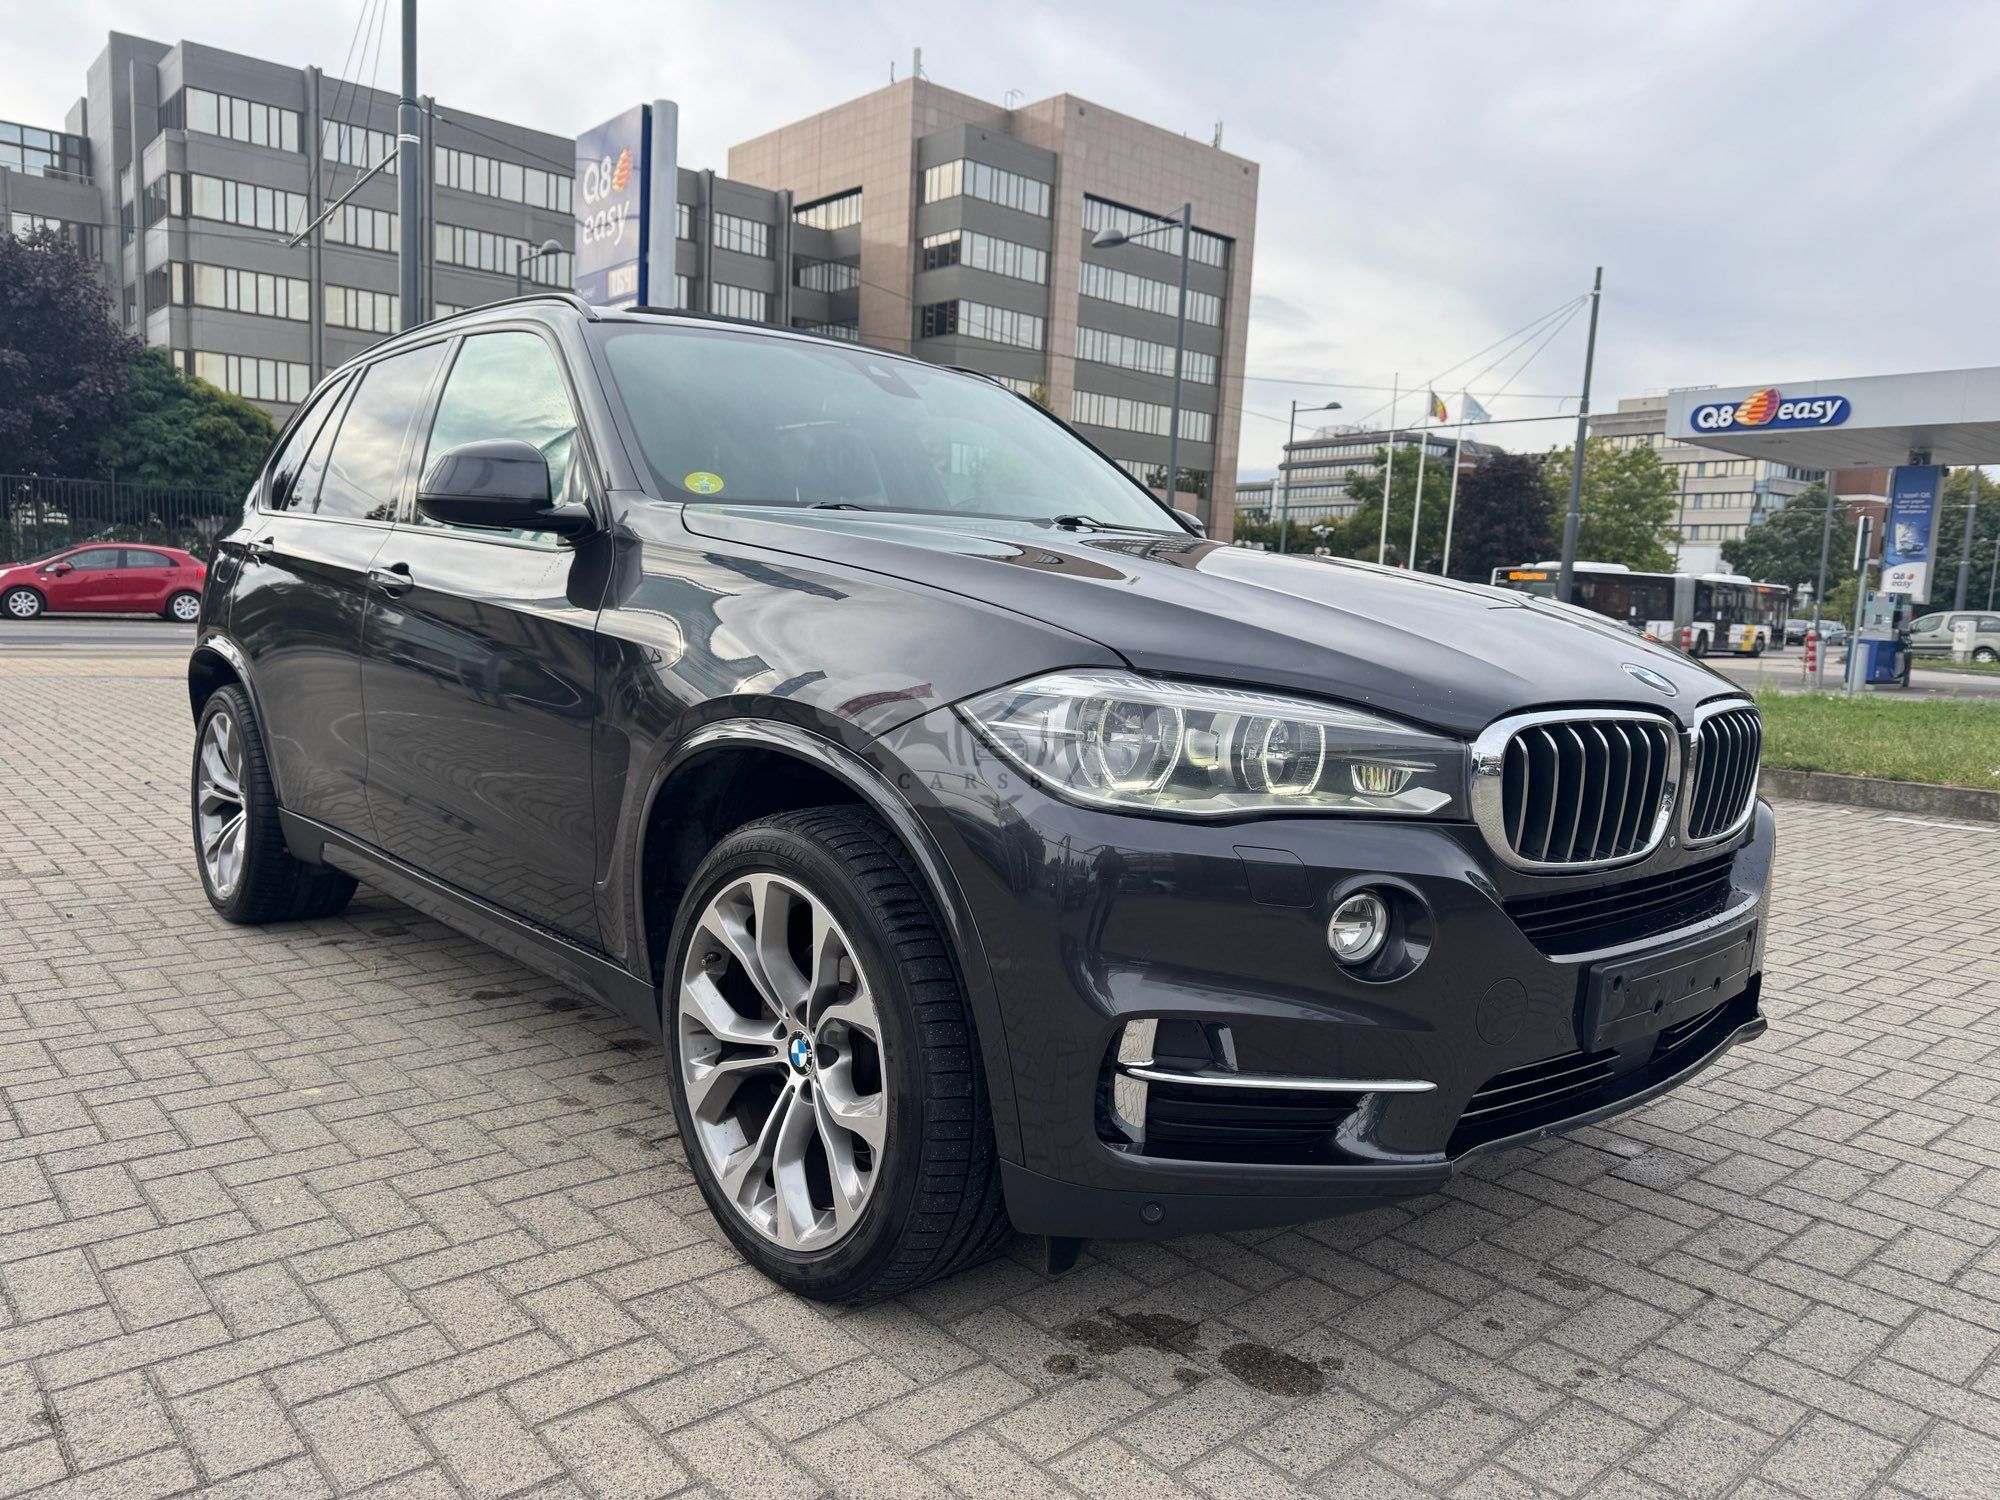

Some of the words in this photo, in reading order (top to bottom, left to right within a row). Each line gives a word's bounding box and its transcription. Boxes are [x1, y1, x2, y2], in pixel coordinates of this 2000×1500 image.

[583, 155, 611, 204] Q8
[583, 201, 630, 247] easy
[1697, 405, 1734, 429] Q8
[1777, 400, 1843, 424] easy
